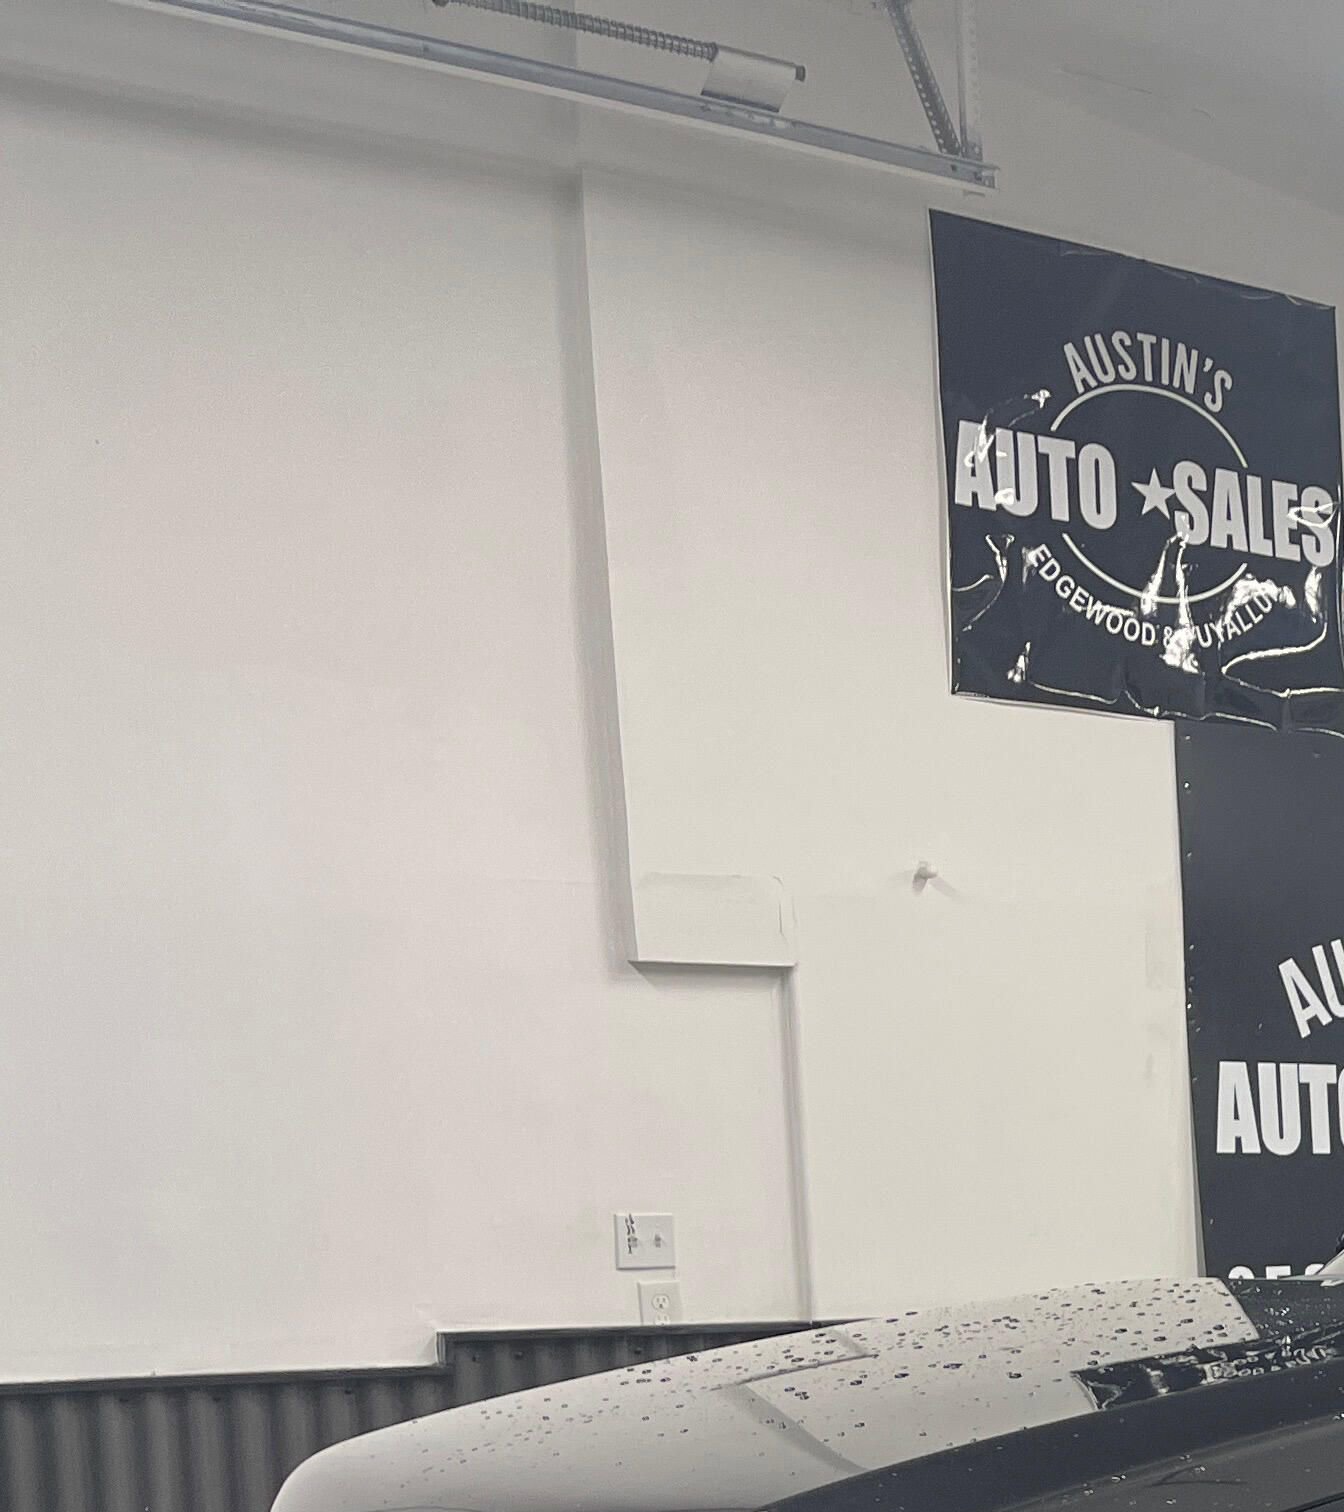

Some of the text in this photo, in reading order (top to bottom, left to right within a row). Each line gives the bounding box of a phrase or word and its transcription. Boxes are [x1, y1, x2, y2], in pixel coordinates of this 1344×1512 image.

[1063, 331, 1233, 412] AUSTIN'S
[954, 419, 1334, 567] AUTO SALES
[1031, 544, 1157, 646] EDGEWOOD
[1188, 591, 1281, 648] UYALLU
